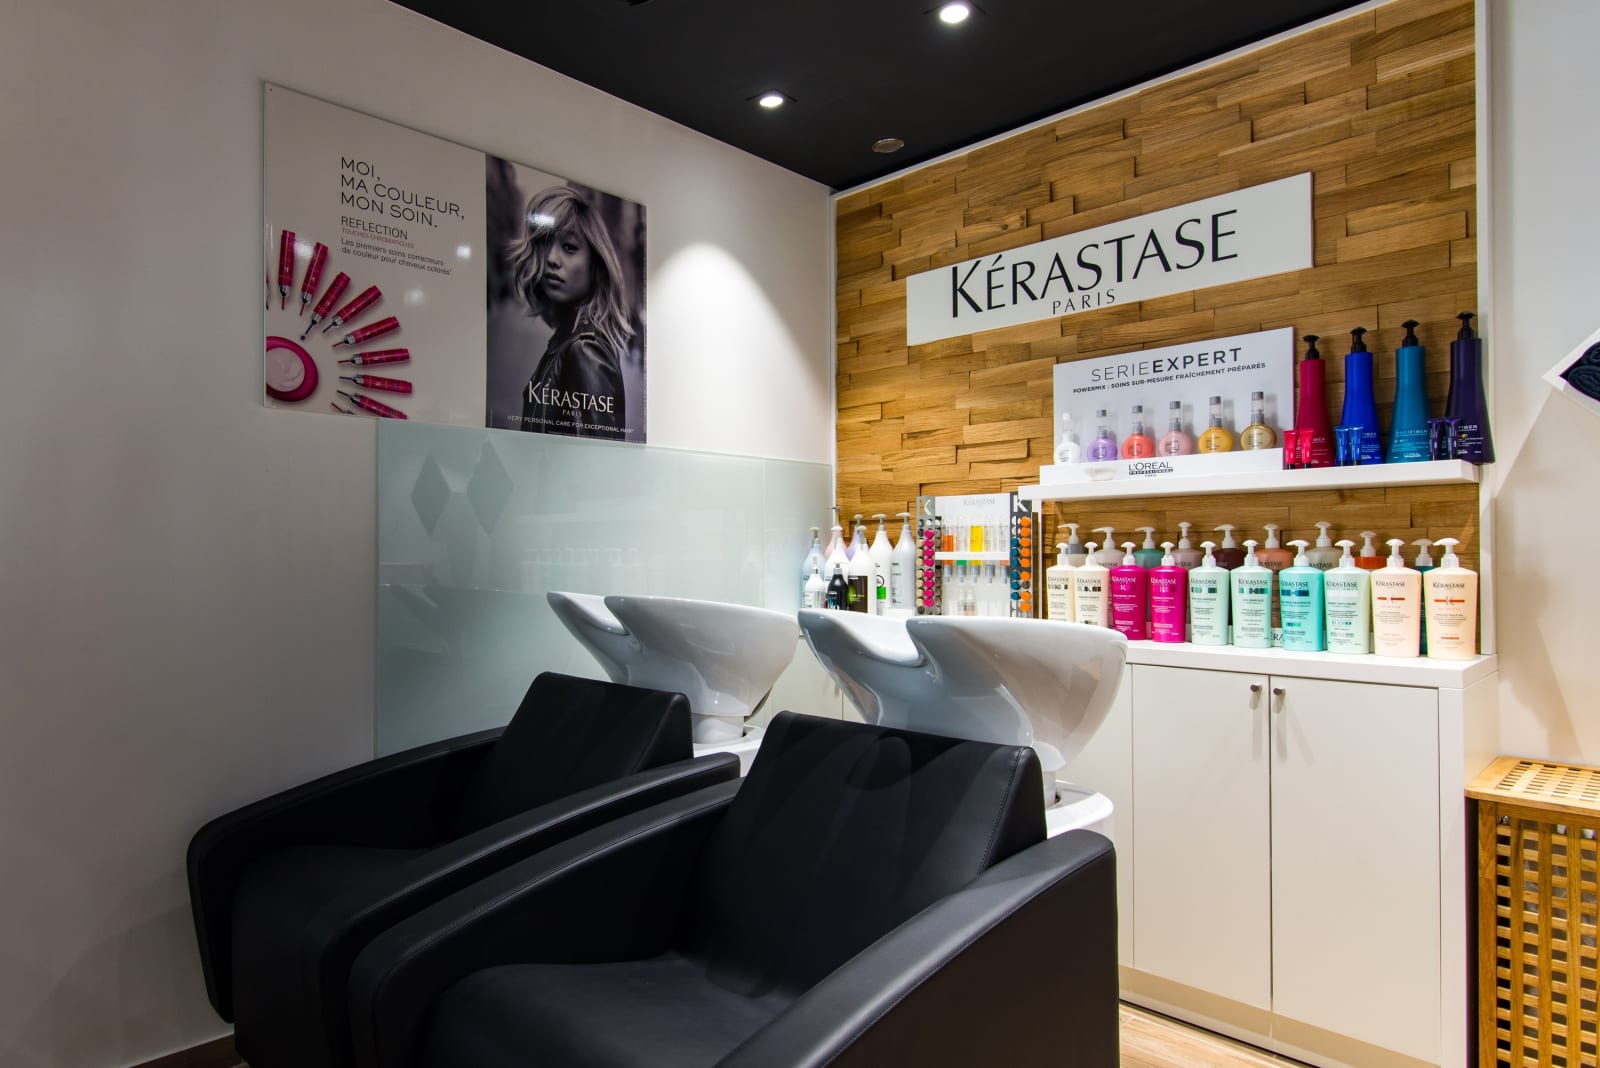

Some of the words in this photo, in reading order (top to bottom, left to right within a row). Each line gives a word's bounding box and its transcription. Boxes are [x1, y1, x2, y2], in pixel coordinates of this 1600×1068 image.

[341, 156, 381, 181] MOI,
[341, 174, 369, 194] MA
[373, 183, 465, 221] COULEUR,
[341, 191, 384, 215] MON
[390, 204, 438, 228] SOIN.
[341, 215, 408, 240] REFLECTION
[341, 237, 354, 247] Les
[355, 241, 387, 254] premiers
[388, 249, 406, 258] soins
[407, 253, 444, 266] correcteurs
[341, 246, 351, 255] de
[352, 248, 380, 261] couleur
[380, 255, 396, 265] pour
[398, 258, 426, 271] cheveux
[951, 208, 1239, 318] KÉRASTASE
[1052, 288, 1116, 315] PARIS
[1072, 383, 1106, 394] POWERMIX
[1110, 381, 1130, 389] SOINS
[1131, 375, 1174, 386] SUR-MESURE
[1227, 361, 1266, 373] PRÉPARÉS
[528, 380, 615, 413] KÉRASTASE
[524, 417, 555, 426] PERSONAL
[584, 423, 620, 433] EXCEPTIONAL
[562, 408, 583, 418] PARIS
